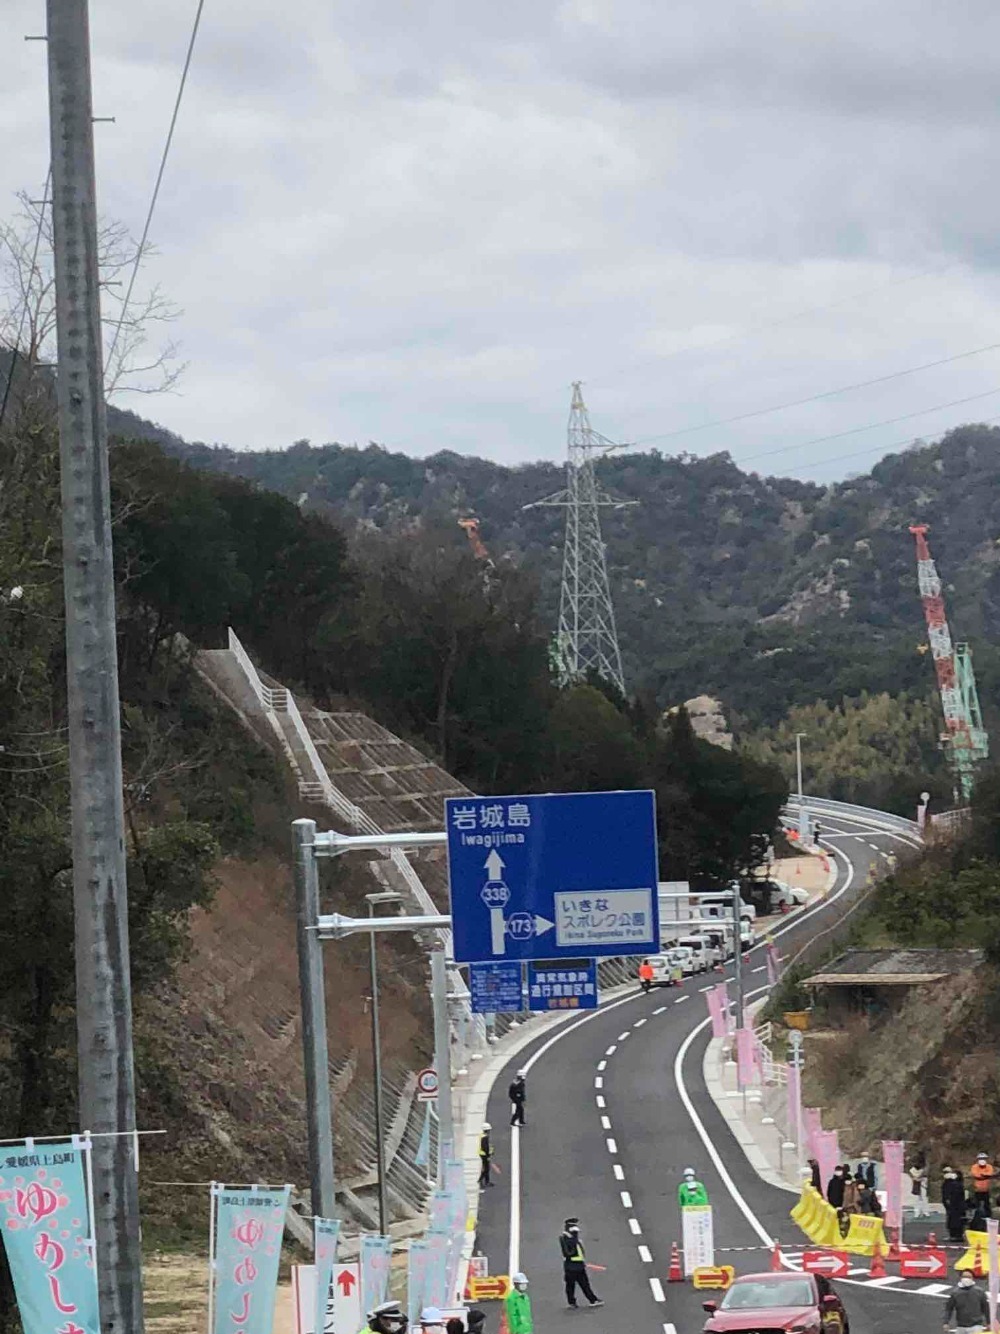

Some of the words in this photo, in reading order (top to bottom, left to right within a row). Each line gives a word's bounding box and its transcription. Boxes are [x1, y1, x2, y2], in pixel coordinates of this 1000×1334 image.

[452, 803, 531, 829] 岩城島
[461, 832, 525, 847] Iwagijima
[484, 888, 507, 901] 338
[562, 898, 608, 912] いきな
[511, 919, 531, 933] 173
[5, 1152, 75, 1168] 愛媛県上島町
